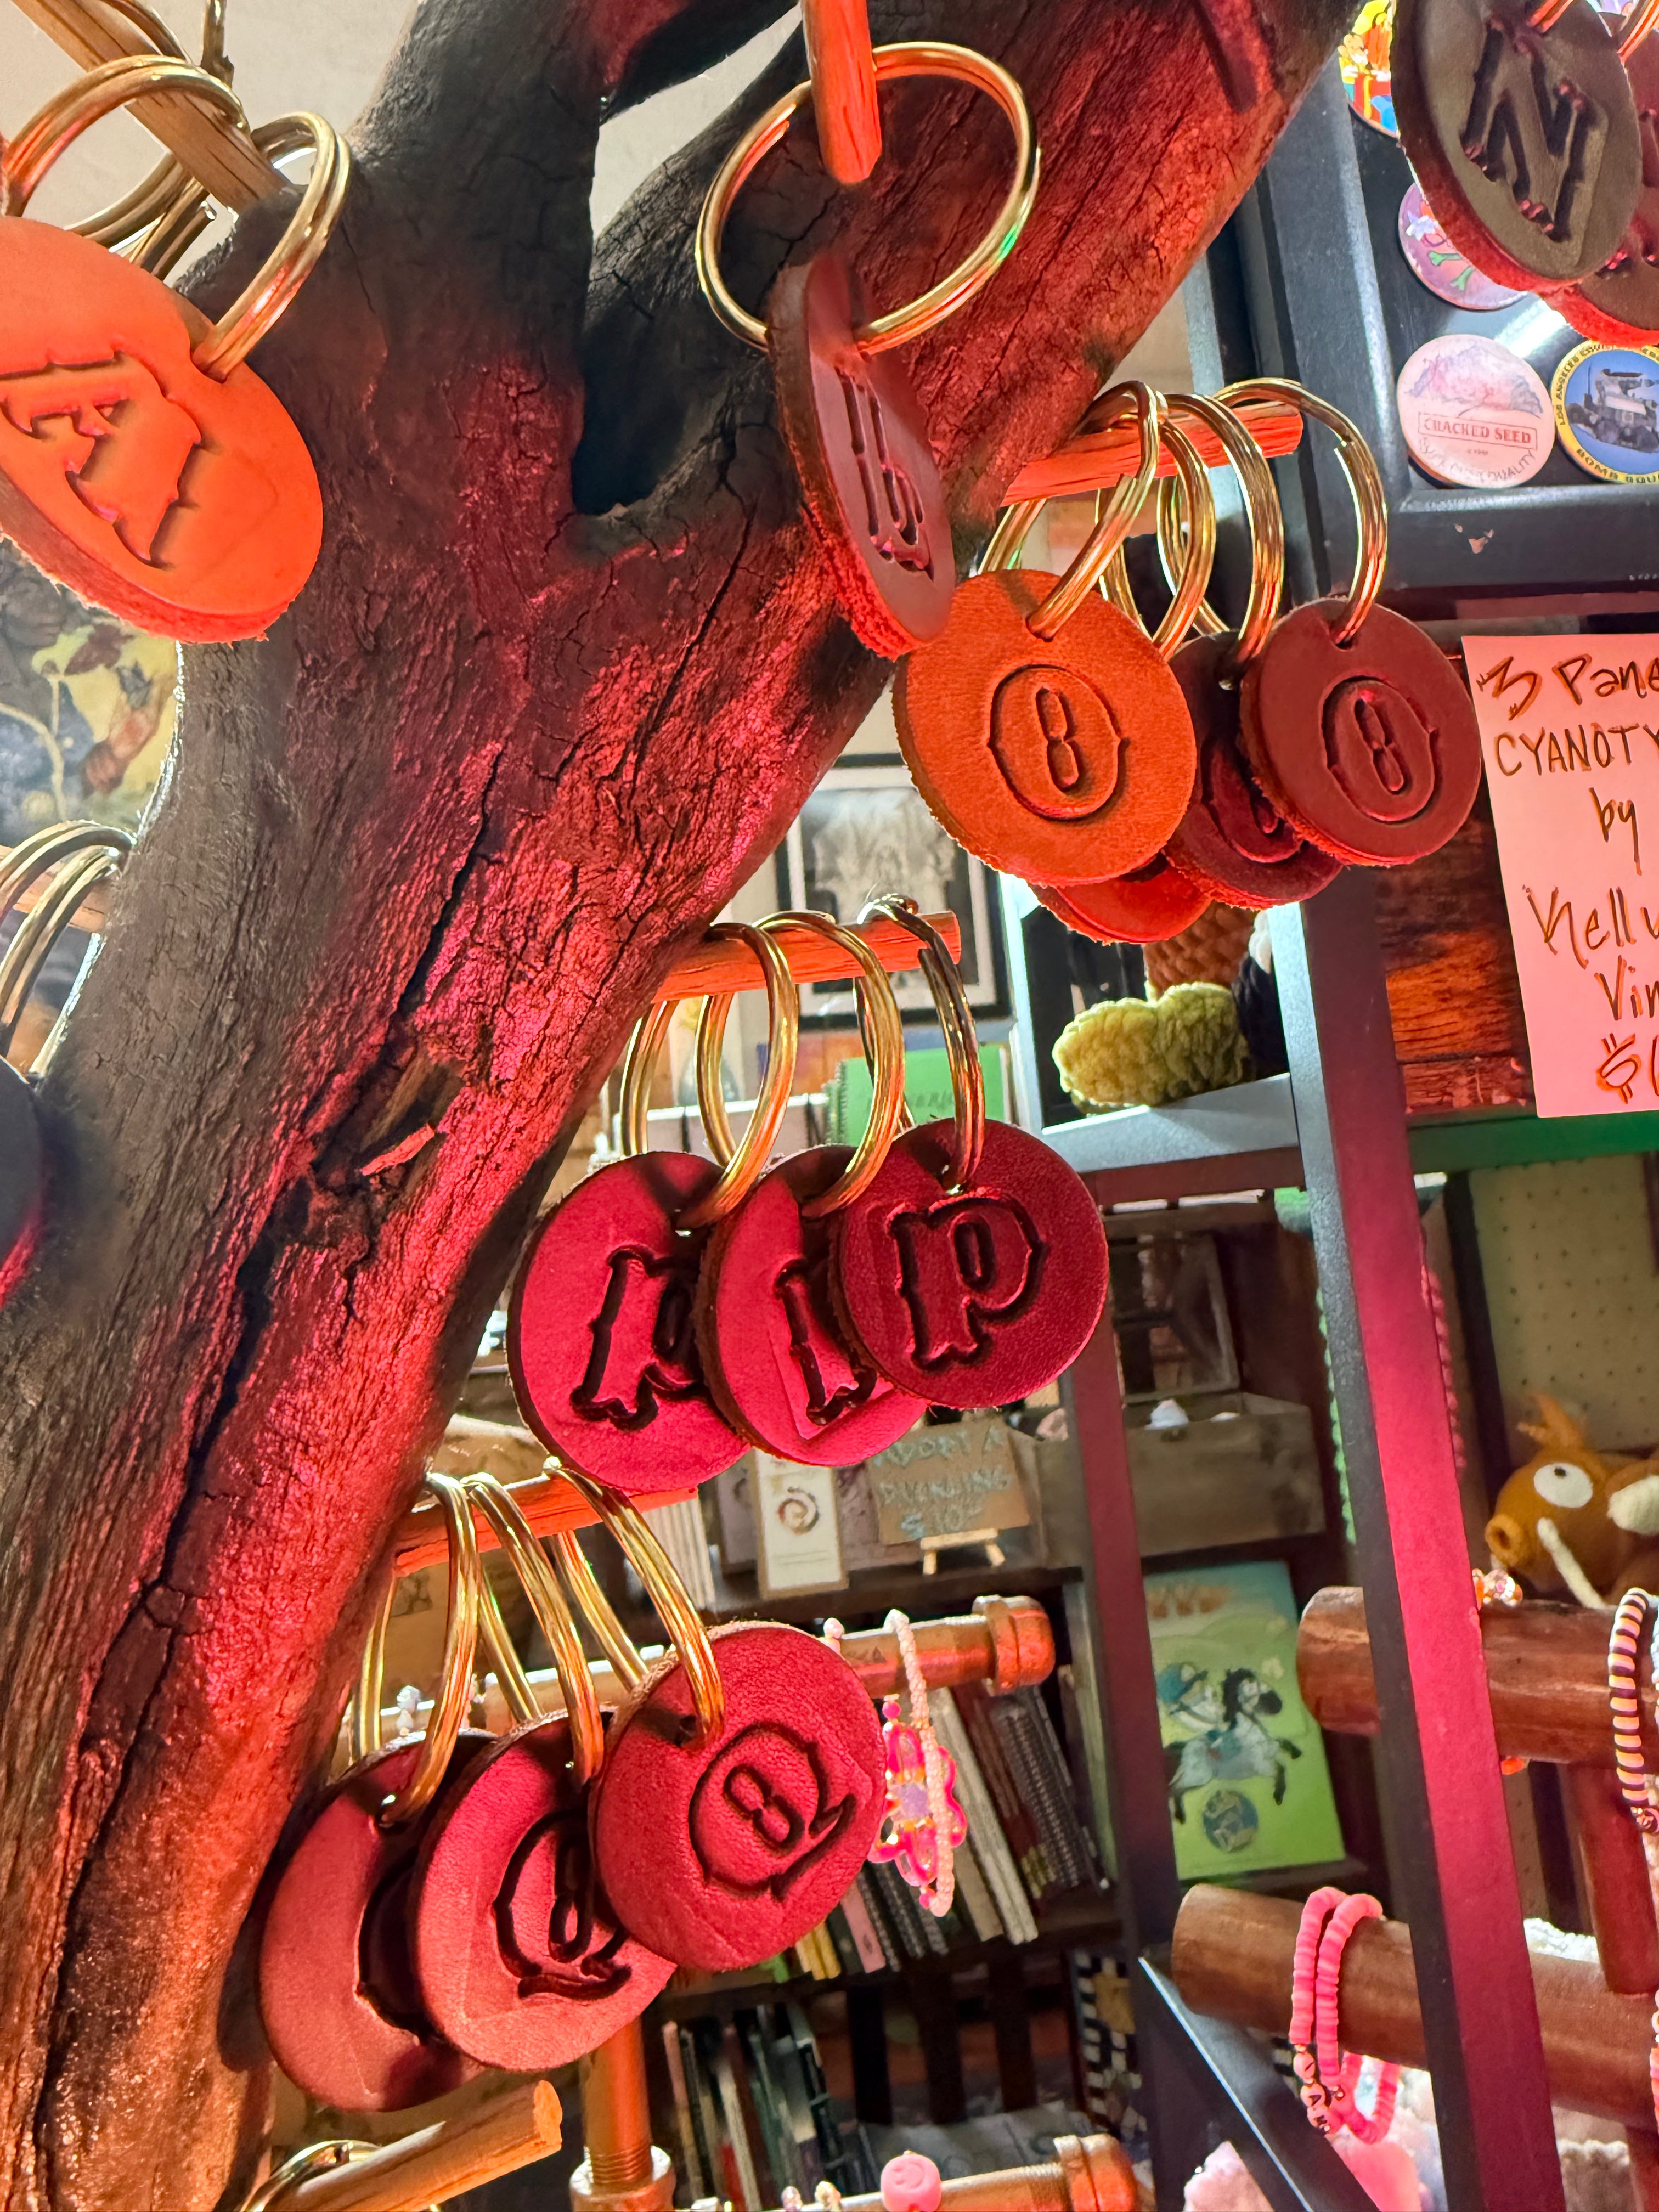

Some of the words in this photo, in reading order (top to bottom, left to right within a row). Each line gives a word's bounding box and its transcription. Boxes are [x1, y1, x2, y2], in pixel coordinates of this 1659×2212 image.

[0, 343, 206, 569] A
[1494, 426, 1532, 444] SEED
[1576, 448, 1618, 481] BOMB
[1625, 472, 1659, 484] SQU
[1477, 654, 1543, 722] 3
[1589, 787, 1643, 876] by
[888, 1187, 1049, 1373] P
[687, 1722, 857, 1903] Q
